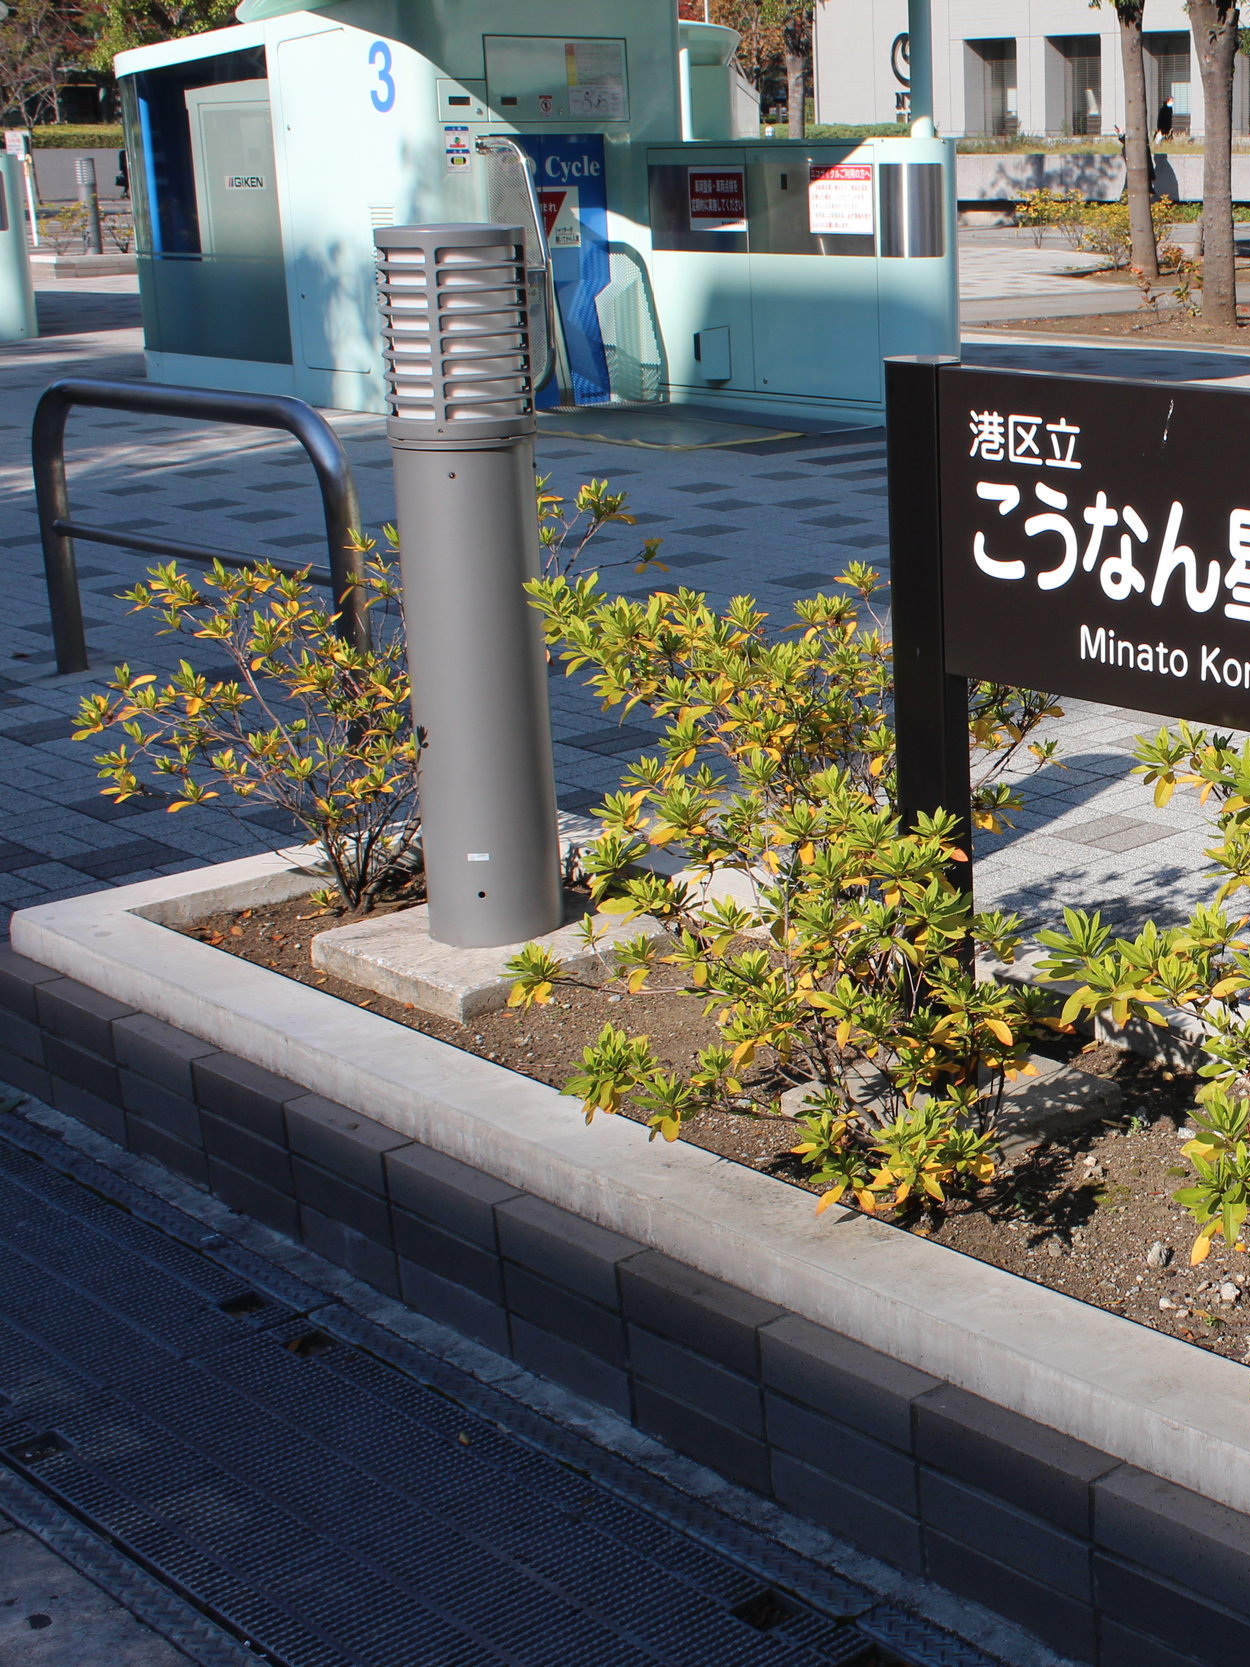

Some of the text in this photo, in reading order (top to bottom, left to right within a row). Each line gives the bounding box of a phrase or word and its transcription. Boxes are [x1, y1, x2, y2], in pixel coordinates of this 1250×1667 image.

[368, 41, 396, 113] 3
[234, 176, 264, 188] GIKEN
[544, 155, 600, 182] Cycle
[969, 410, 1082, 470] 港区立
[1080, 624, 1189, 678] Minato
